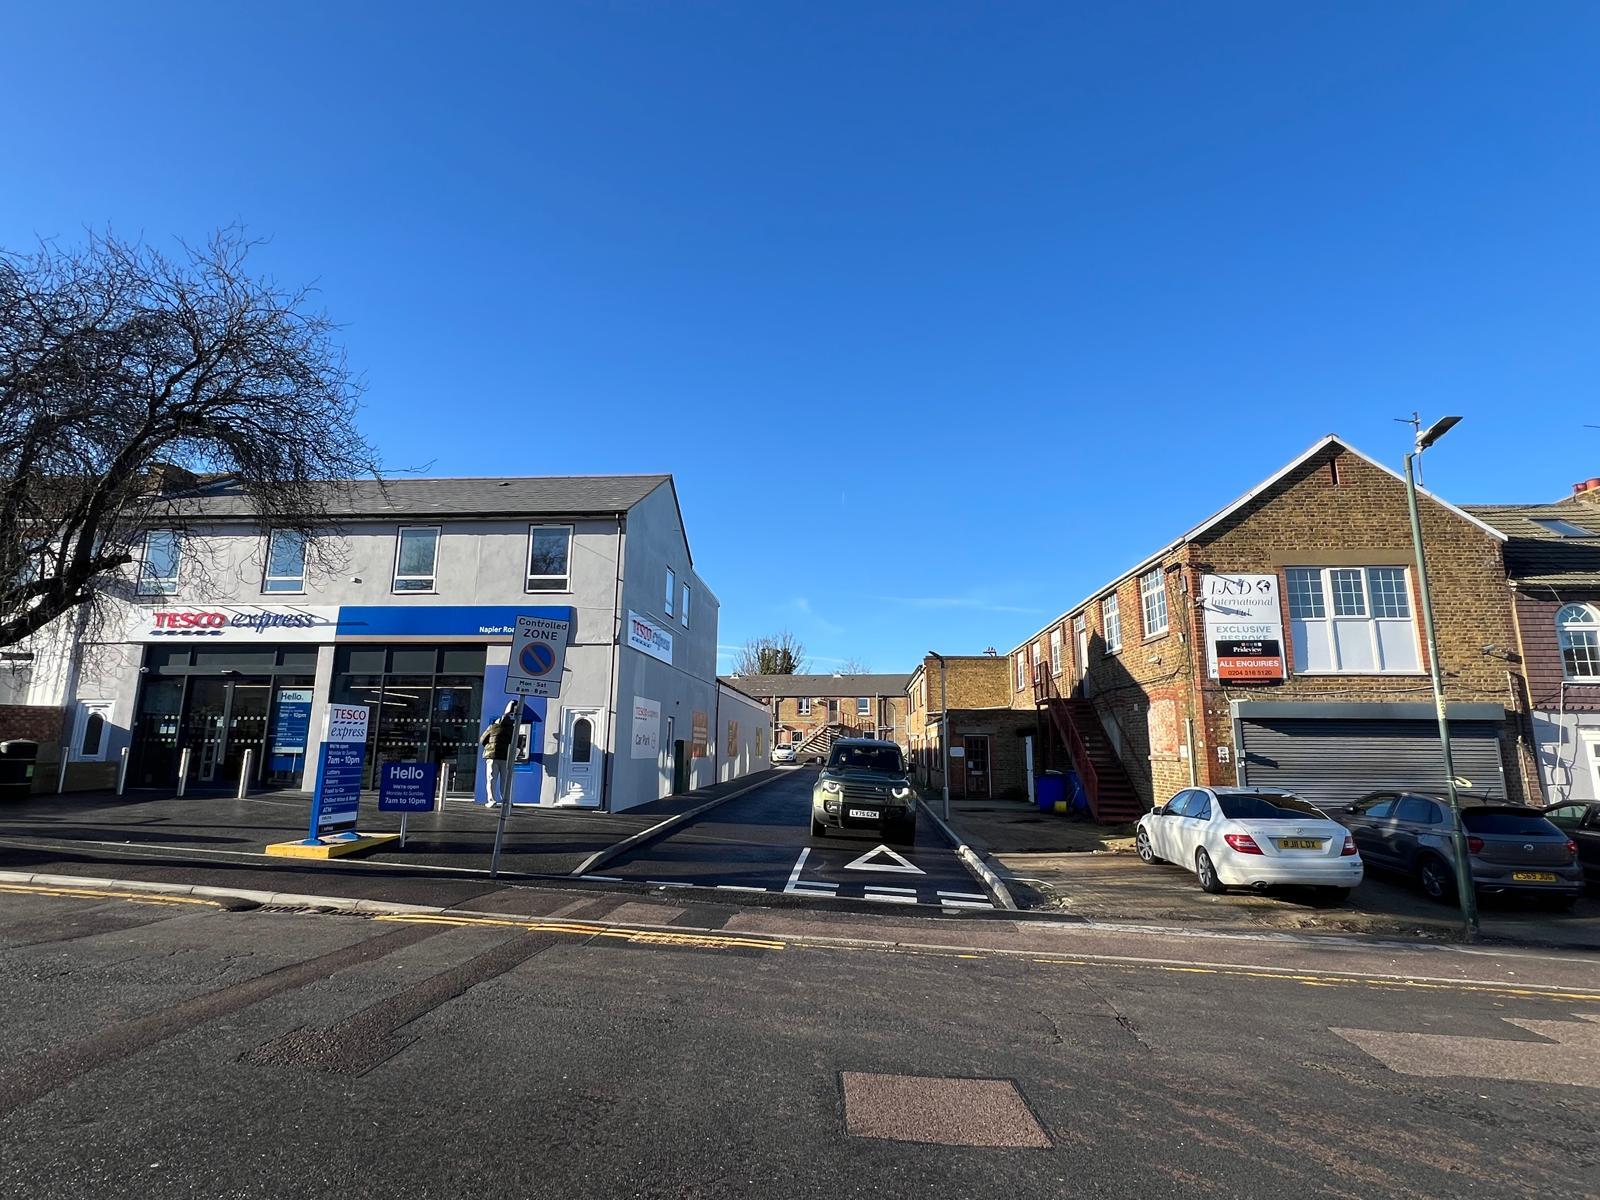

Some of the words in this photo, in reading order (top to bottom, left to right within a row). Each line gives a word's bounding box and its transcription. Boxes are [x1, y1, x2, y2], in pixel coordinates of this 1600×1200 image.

[1211, 596, 1273, 606] International
[153, 612, 228, 629] TESCO
[231, 611, 315, 634] express
[518, 617, 568, 630] Controlled
[479, 626, 502, 634] Napier
[523, 628, 559, 641] ZONE
[1216, 625, 1272, 633] EXCLUSIVE
[333, 708, 367, 720] TESCO
[330, 726, 365, 740] express
[327, 756, 340, 764] 7am
[345, 756, 360, 765] 10pm
[390, 767, 424, 779] Hello
[408, 797, 426, 805] 10pm
